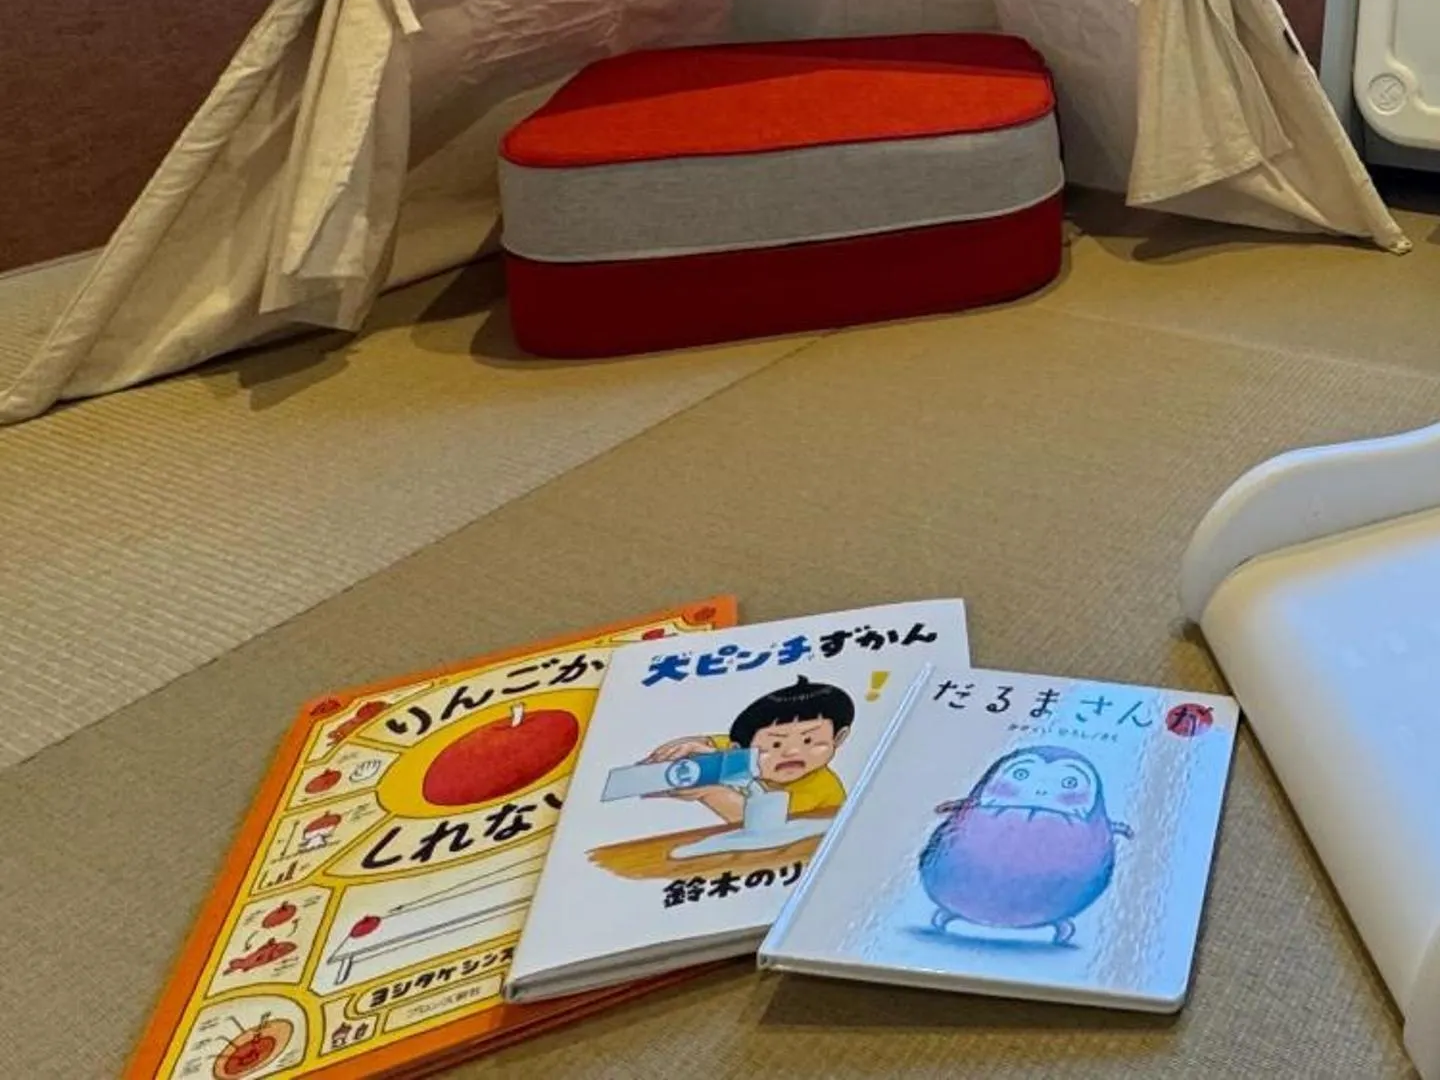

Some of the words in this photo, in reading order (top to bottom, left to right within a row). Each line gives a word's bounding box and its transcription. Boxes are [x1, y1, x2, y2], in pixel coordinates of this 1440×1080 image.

[641, 622, 938, 687] 大ピンチずかん
[386, 654, 605, 736] りんごか
[933, 679, 1214, 738] だるまさんが
[663, 860, 803, 908] 鈴木のり
